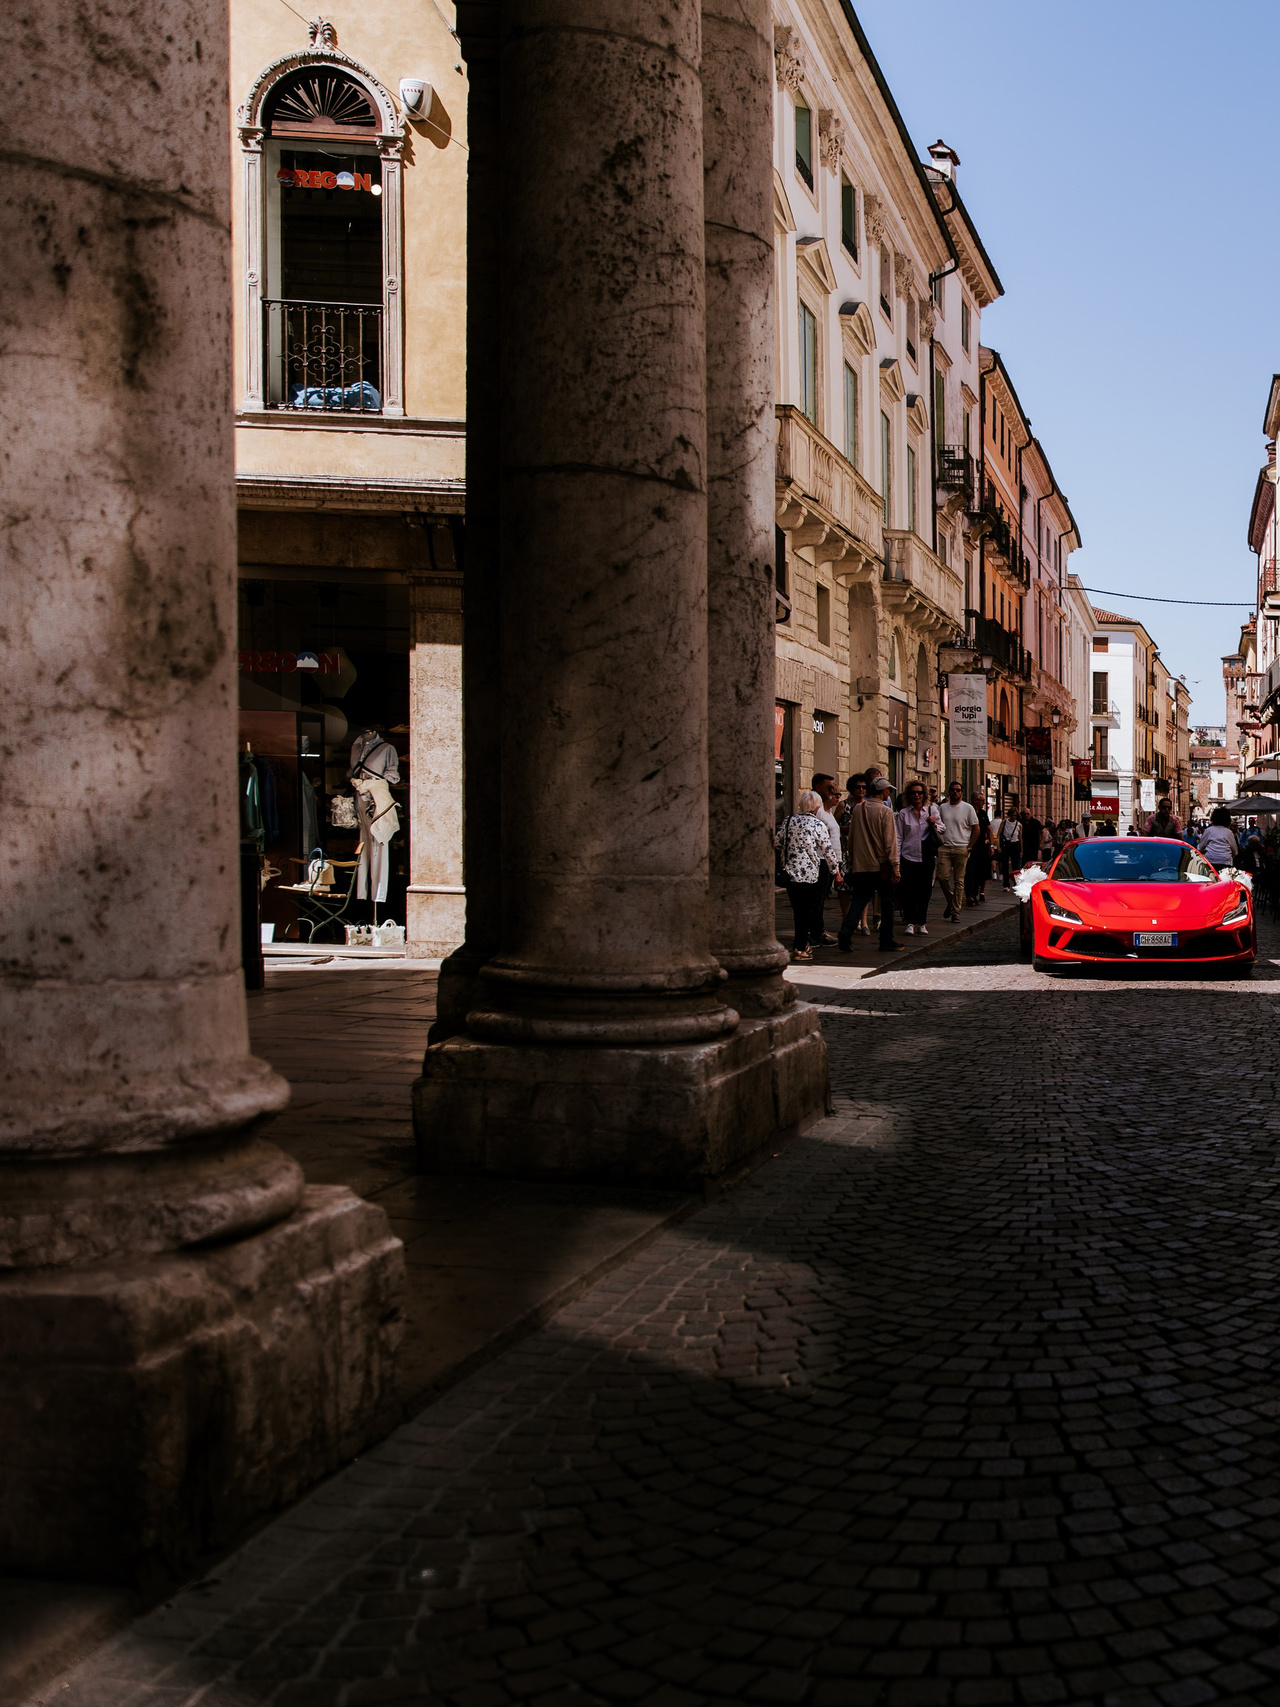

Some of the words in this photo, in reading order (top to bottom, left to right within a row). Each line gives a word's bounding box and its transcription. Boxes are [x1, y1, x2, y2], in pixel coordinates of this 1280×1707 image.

[277, 168, 371, 191] OREGON
[238, 651, 341, 675] REGON
[954, 704, 981, 713] giorgia
[962, 712, 977, 720] lupi
